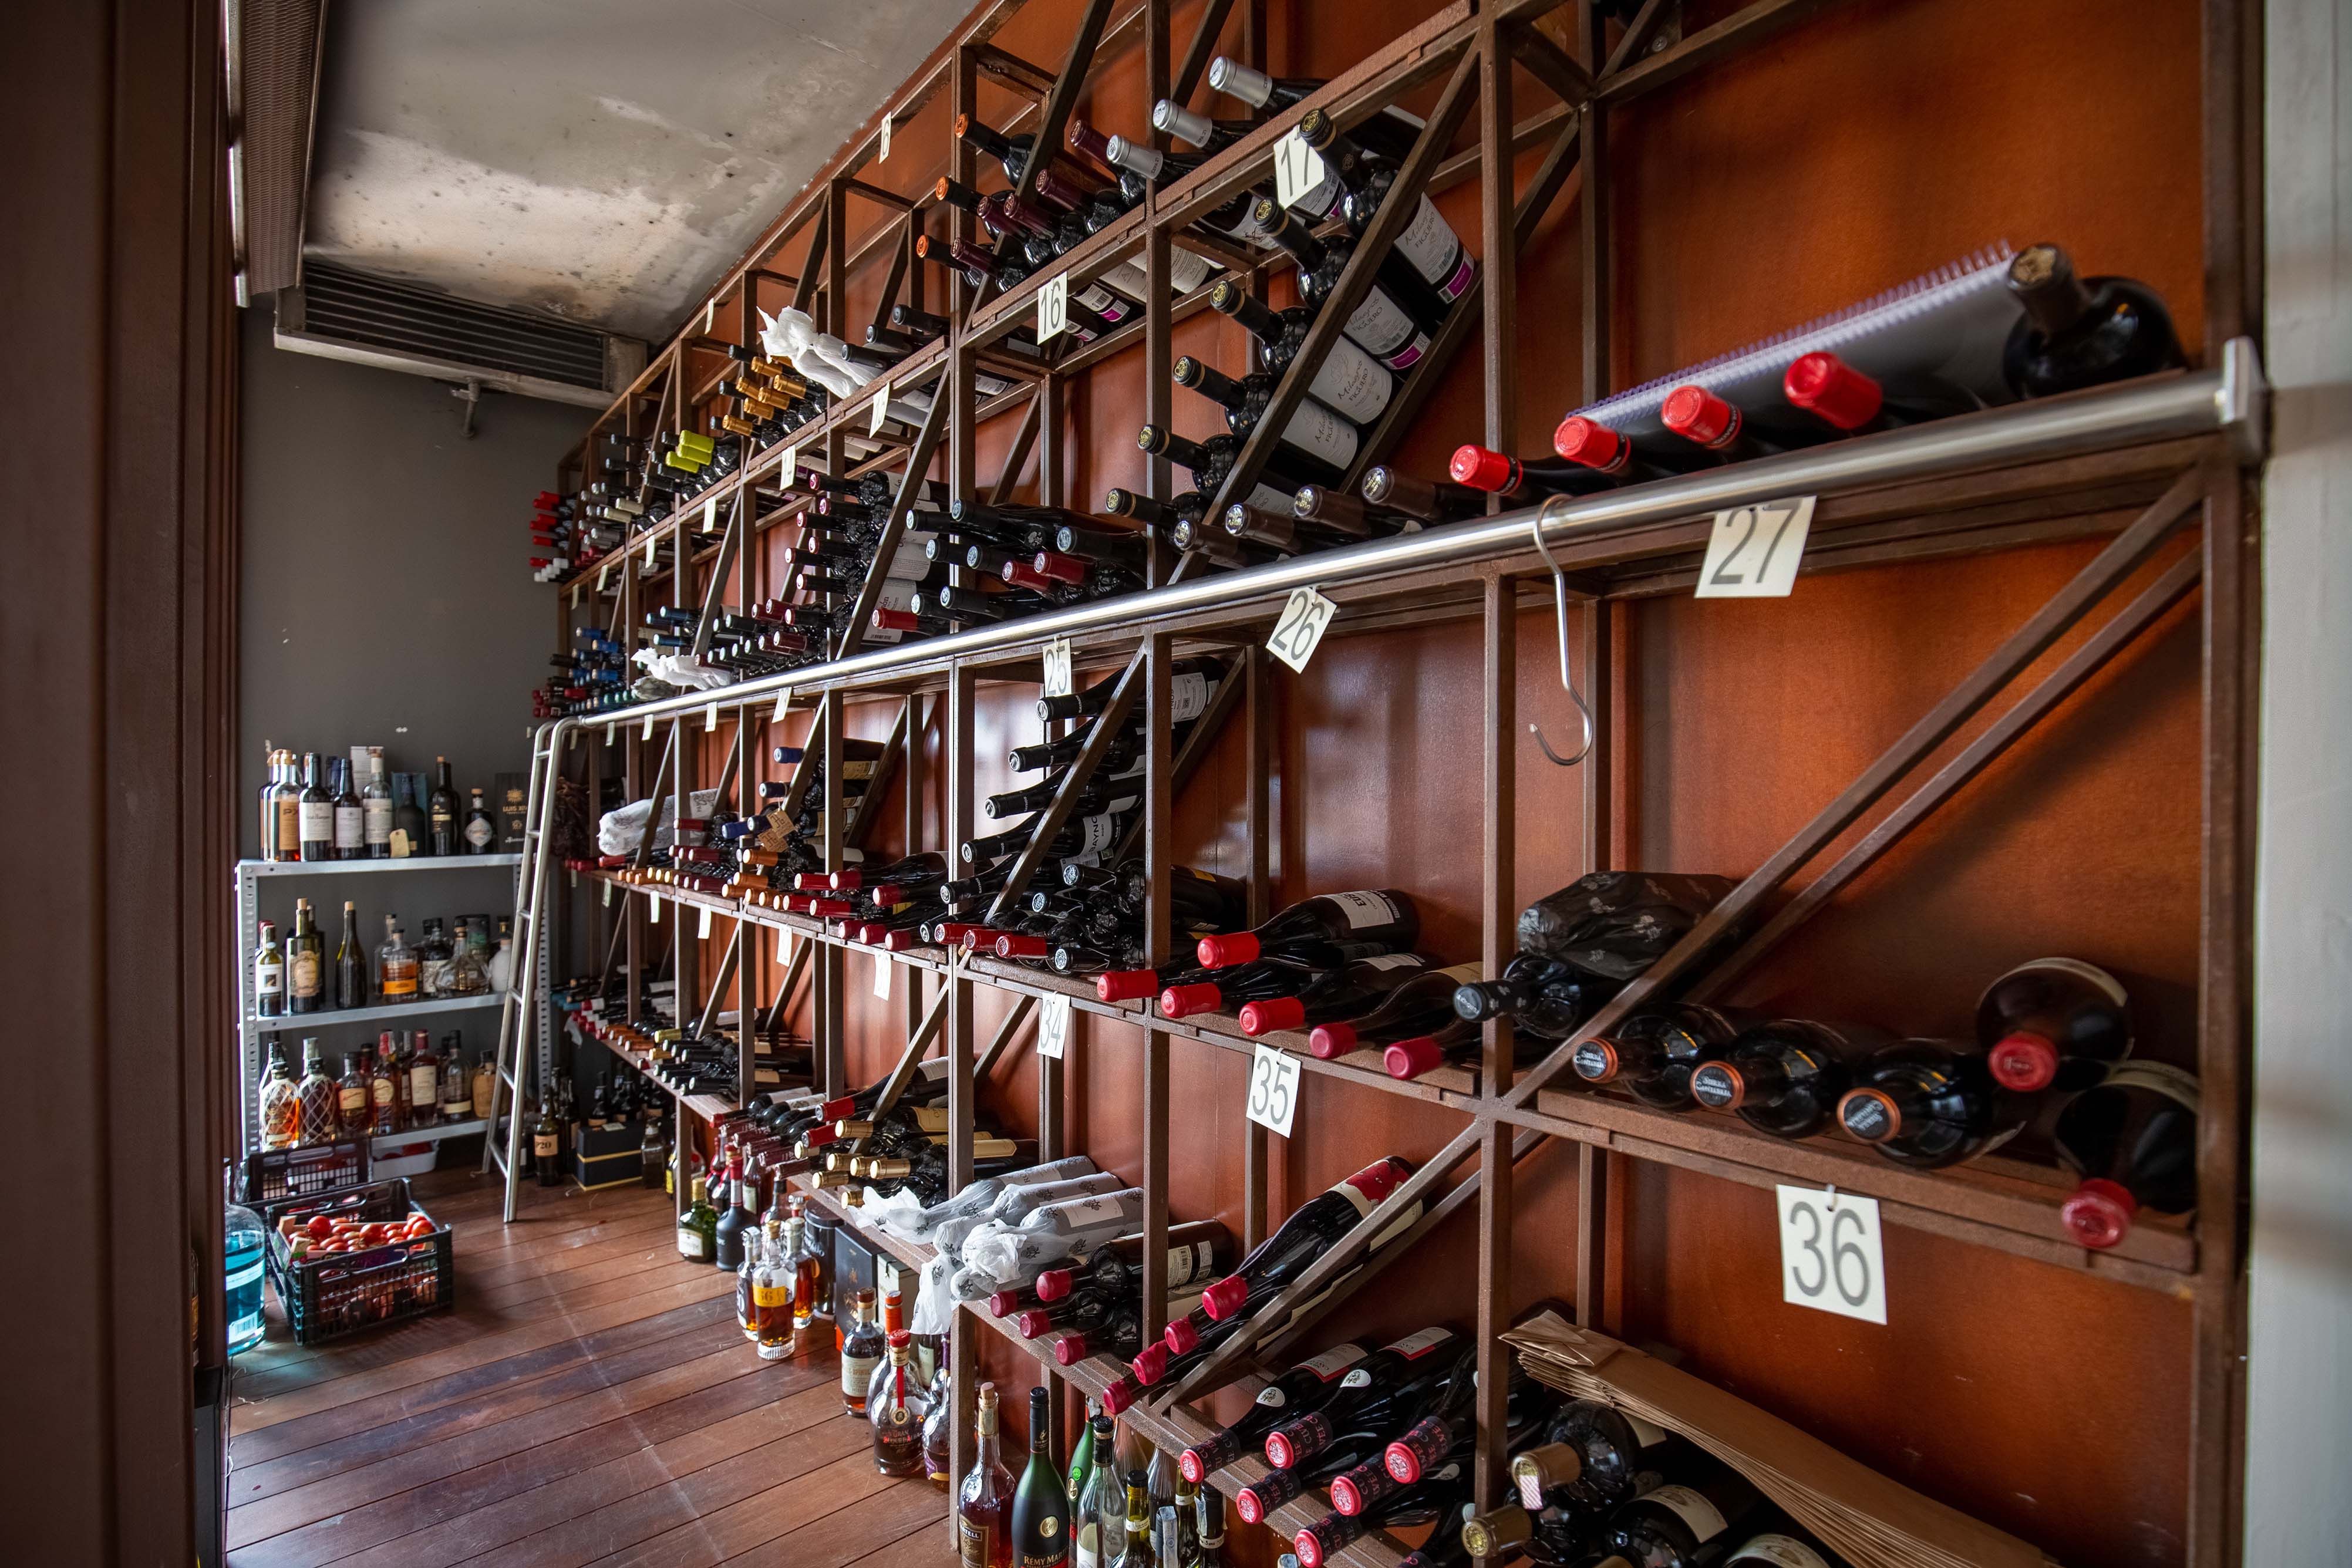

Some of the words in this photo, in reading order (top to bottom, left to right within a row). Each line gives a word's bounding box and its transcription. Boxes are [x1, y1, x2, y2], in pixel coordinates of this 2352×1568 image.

[882, 119, 890, 157] 6
[1281, 136, 1311, 196] 17
[1414, 211, 1436, 248] FIGUERO
[1041, 280, 1061, 335] 16
[1337, 359, 1363, 400] Milagros
[1348, 368, 1369, 403] FIGUERO
[1710, 503, 1803, 585] 27
[1271, 590, 1325, 660] 26
[1045, 645, 1068, 697] 25
[1089, 817, 1099, 853] BAYNO
[1040, 1000, 1062, 1052] 34
[1252, 1055, 1292, 1125] 35
[1788, 1201, 1872, 1307] 36
[1024, 1555, 1046, 1567] RÉMY
